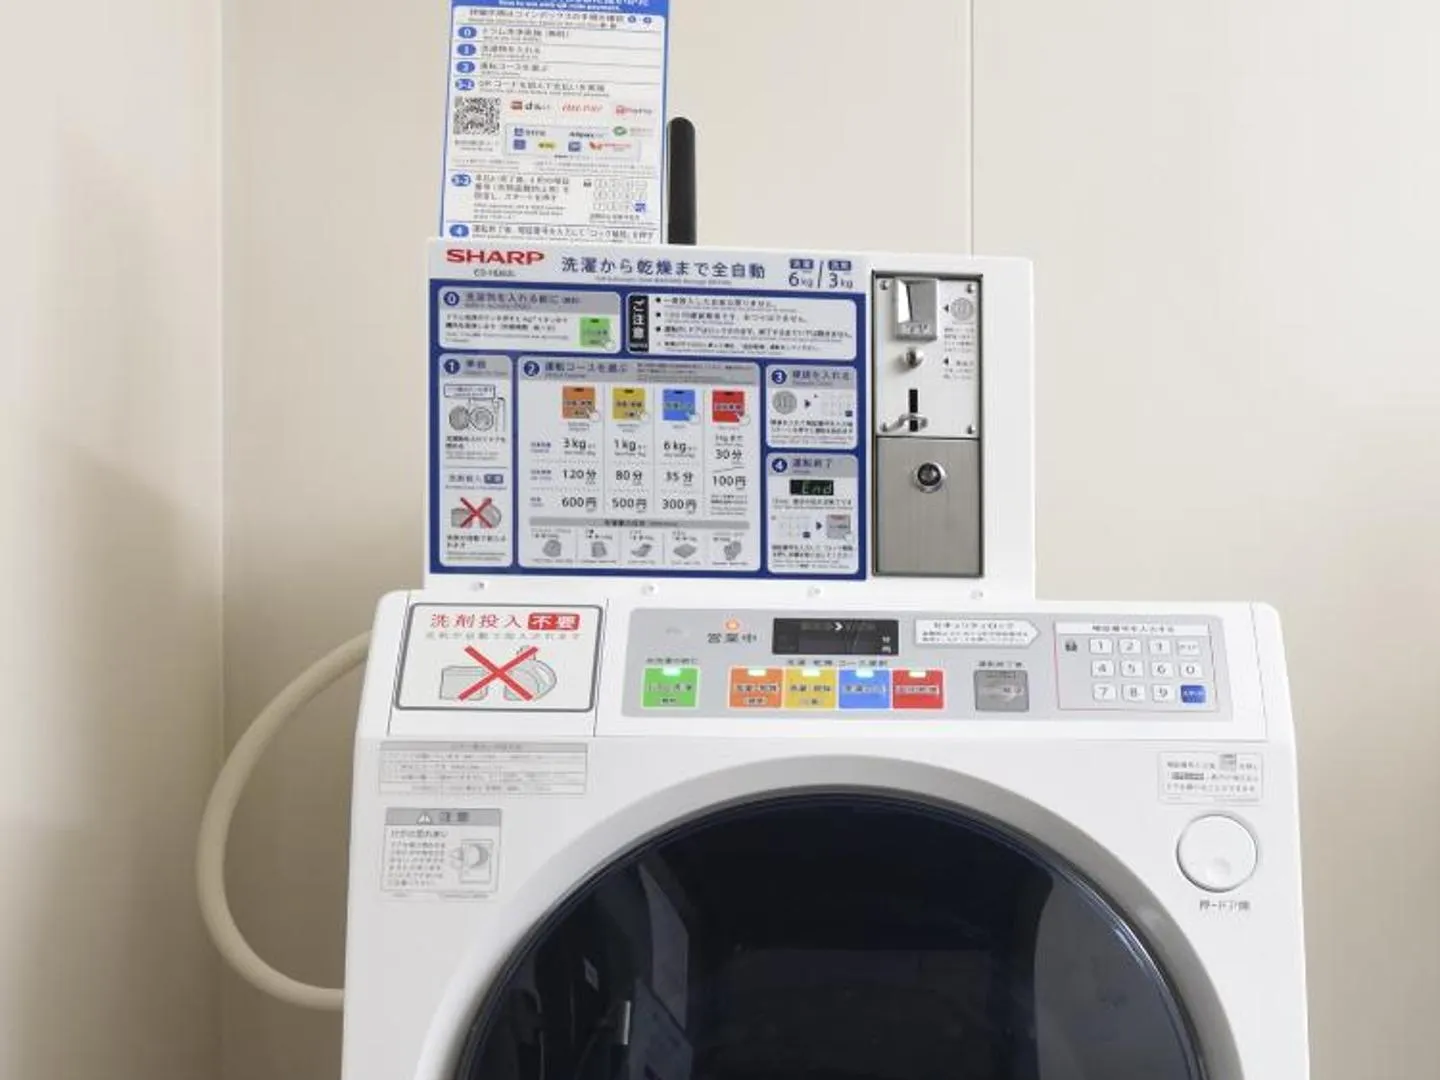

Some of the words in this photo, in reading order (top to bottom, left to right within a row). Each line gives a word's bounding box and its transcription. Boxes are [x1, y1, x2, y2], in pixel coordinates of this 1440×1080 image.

[446, 249, 545, 265] SHARP
[561, 256, 765, 280] 洗濯から乾燥まで全自動
[430, 613, 523, 630] 洗剤投入
[530, 614, 578, 631] 不要
